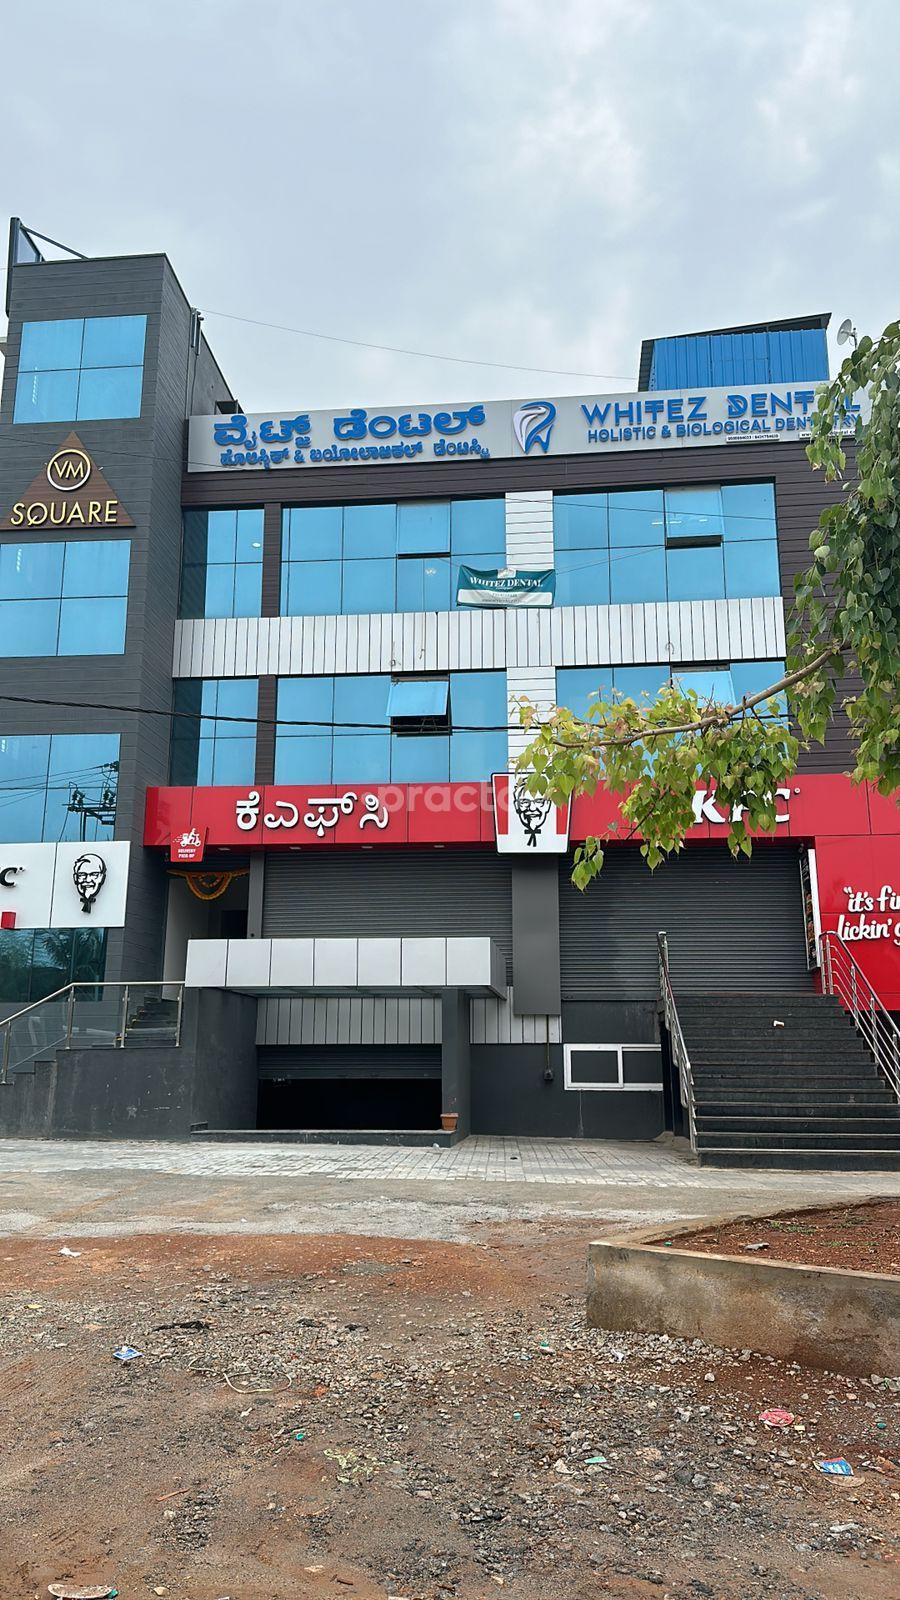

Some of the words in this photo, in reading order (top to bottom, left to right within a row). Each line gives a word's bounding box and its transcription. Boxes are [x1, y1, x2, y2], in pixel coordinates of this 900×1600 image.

[333, 405, 486, 440] ಡೆಂಟಲ್
[581, 396, 707, 427] WHITEZ
[727, 390, 861, 418] DENTL
[588, 426, 656, 443] HOLISTIC
[661, 425, 672, 438] &
[676, 418, 772, 438] BIOLOGICAL
[775, 412, 862, 433] DENTTRY
[54, 460, 84, 479] VM
[294, 449, 306, 463] &
[10, 500, 118, 525] SQUARE
